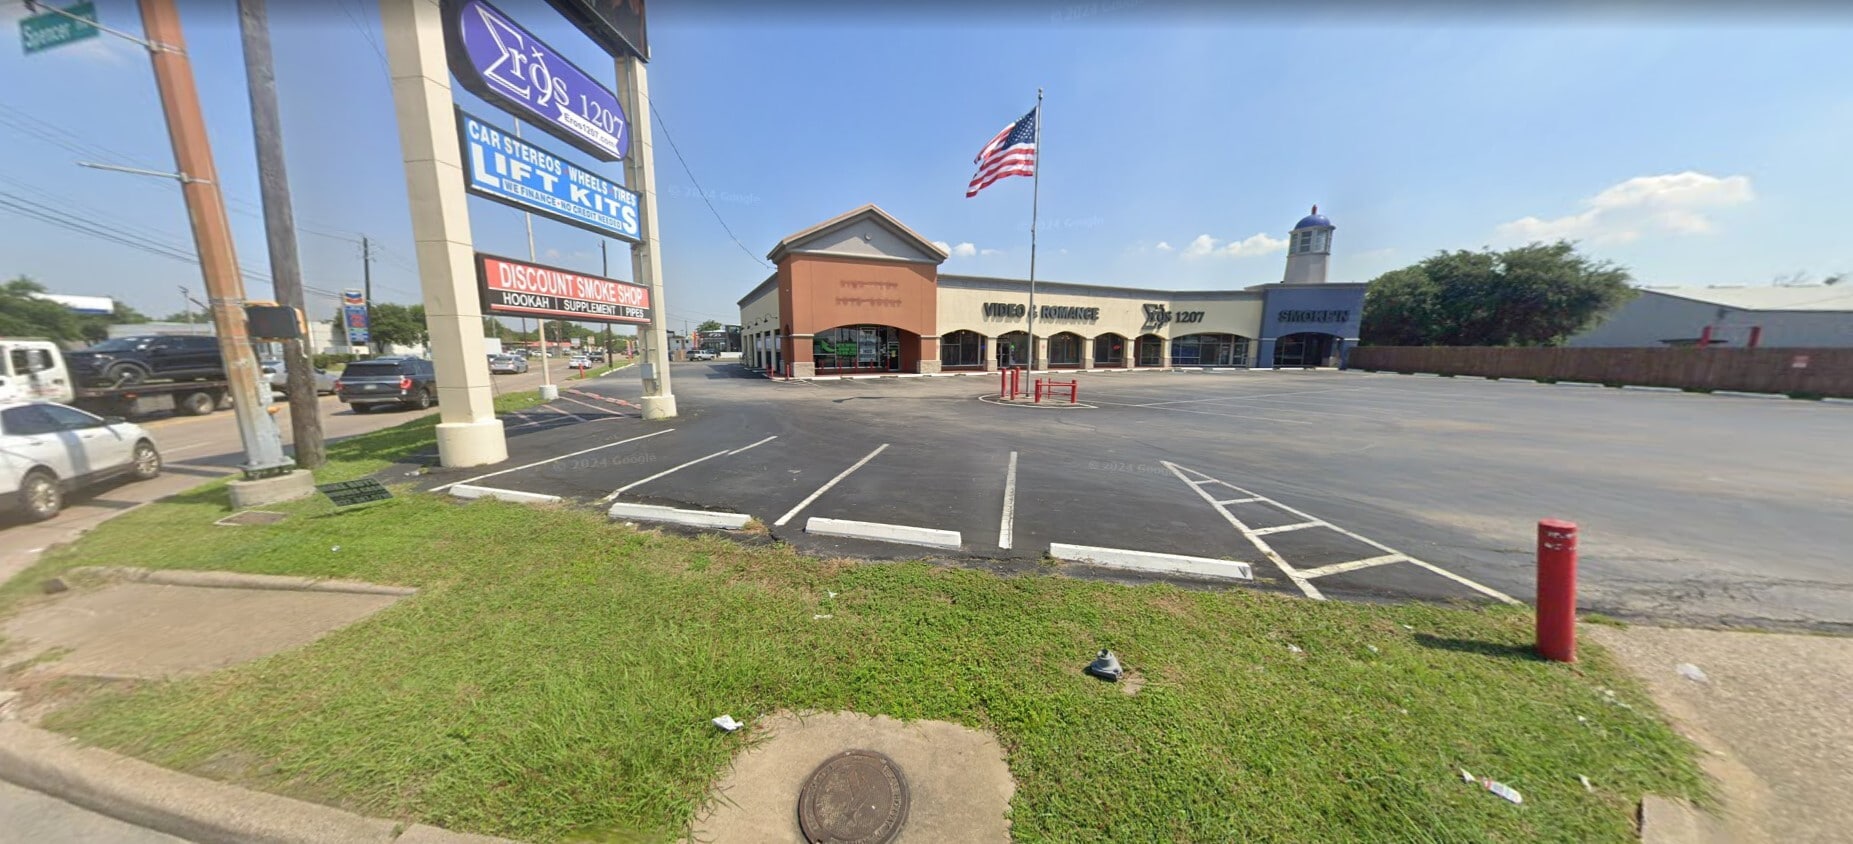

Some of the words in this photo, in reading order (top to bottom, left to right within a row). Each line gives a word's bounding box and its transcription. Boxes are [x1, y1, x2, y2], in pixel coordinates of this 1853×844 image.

[23, 23, 71, 50] Spencer
[580, 94, 624, 139] 1207
[468, 120, 500, 151] CAR
[503, 136, 562, 176] STEREOS
[567, 165, 608, 195] WHEELS
[612, 185, 637, 206] TIRES
[471, 142, 559, 193] LIFT
[569, 183, 637, 235] KITS
[504, 180, 520, 193] WE
[521, 186, 557, 206] FINANCE
[560, 201, 572, 212] NO
[573, 205, 597, 220] CREDIT
[598, 214, 621, 228] NEEDED
[499, 262, 574, 297] DISCOUNT
[576, 276, 617, 303] SMOKE
[618, 285, 643, 306] SHOP
[502, 291, 549, 309] HOOKAH
[563, 299, 616, 316] SUPPLEMENT
[625, 307, 644, 319] PIPES
[983, 302, 1026, 318] VIDEO
[1040, 305, 1100, 321] ROMANCE
[1175, 311, 1205, 324] 1207
